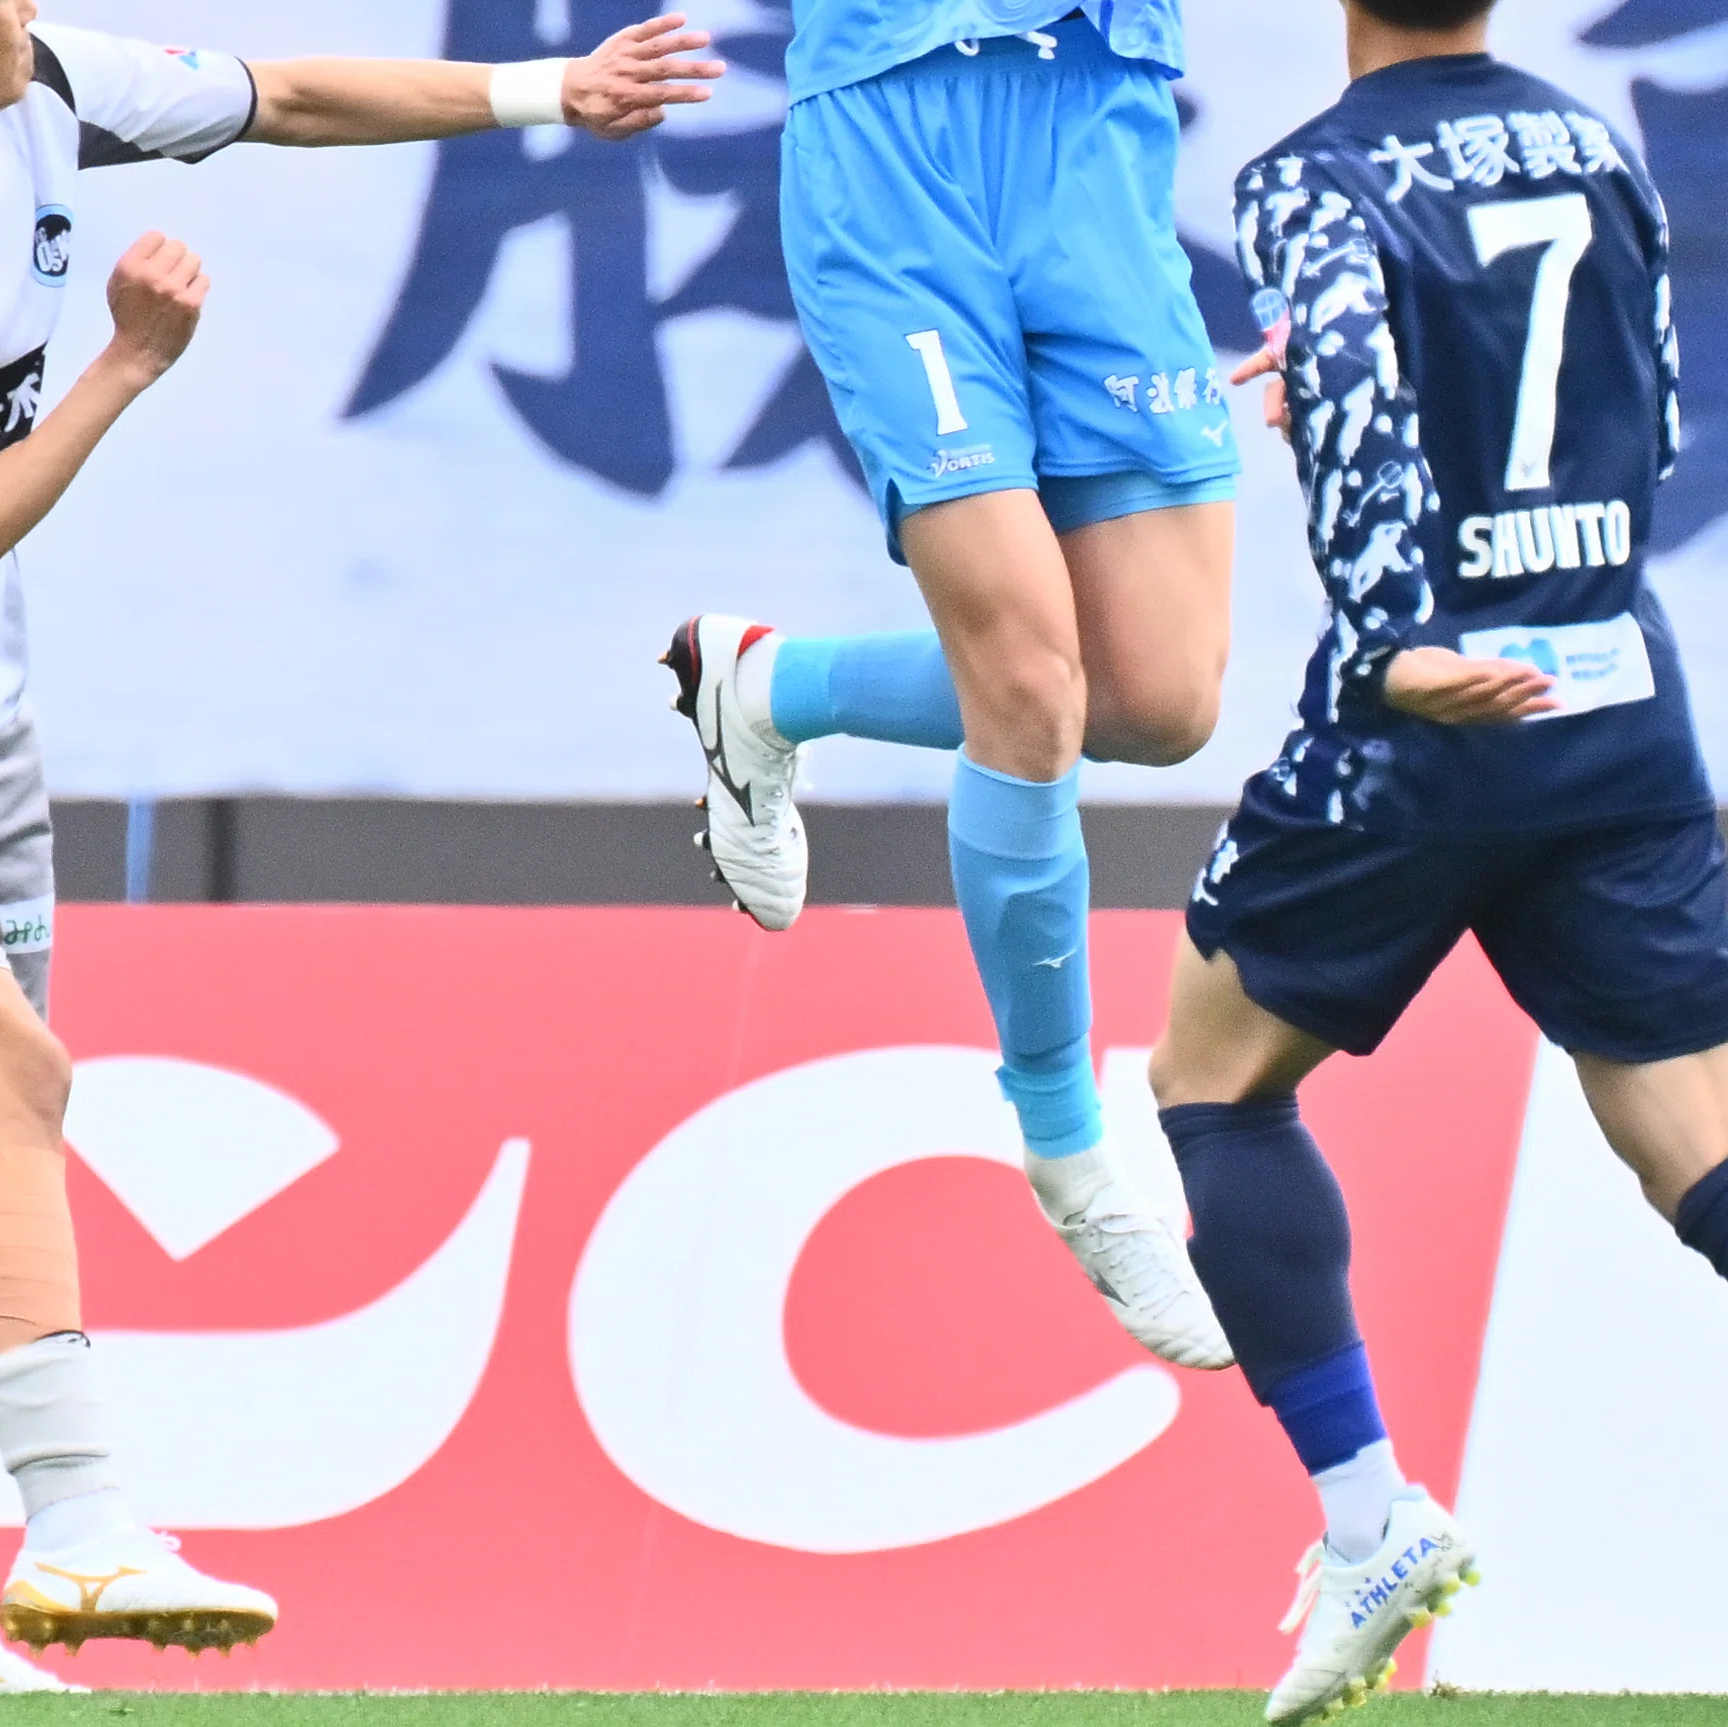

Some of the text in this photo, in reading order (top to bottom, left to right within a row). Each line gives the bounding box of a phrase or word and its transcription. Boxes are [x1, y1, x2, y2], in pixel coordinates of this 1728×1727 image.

[1372, 111, 1624, 203] 大塚製薬
[906, 330, 968, 436] 1
[1468, 193, 1592, 491] 7
[1458, 501, 1631, 578] SHUNTO
[1351, 1538, 1439, 1629] ATHLETA
